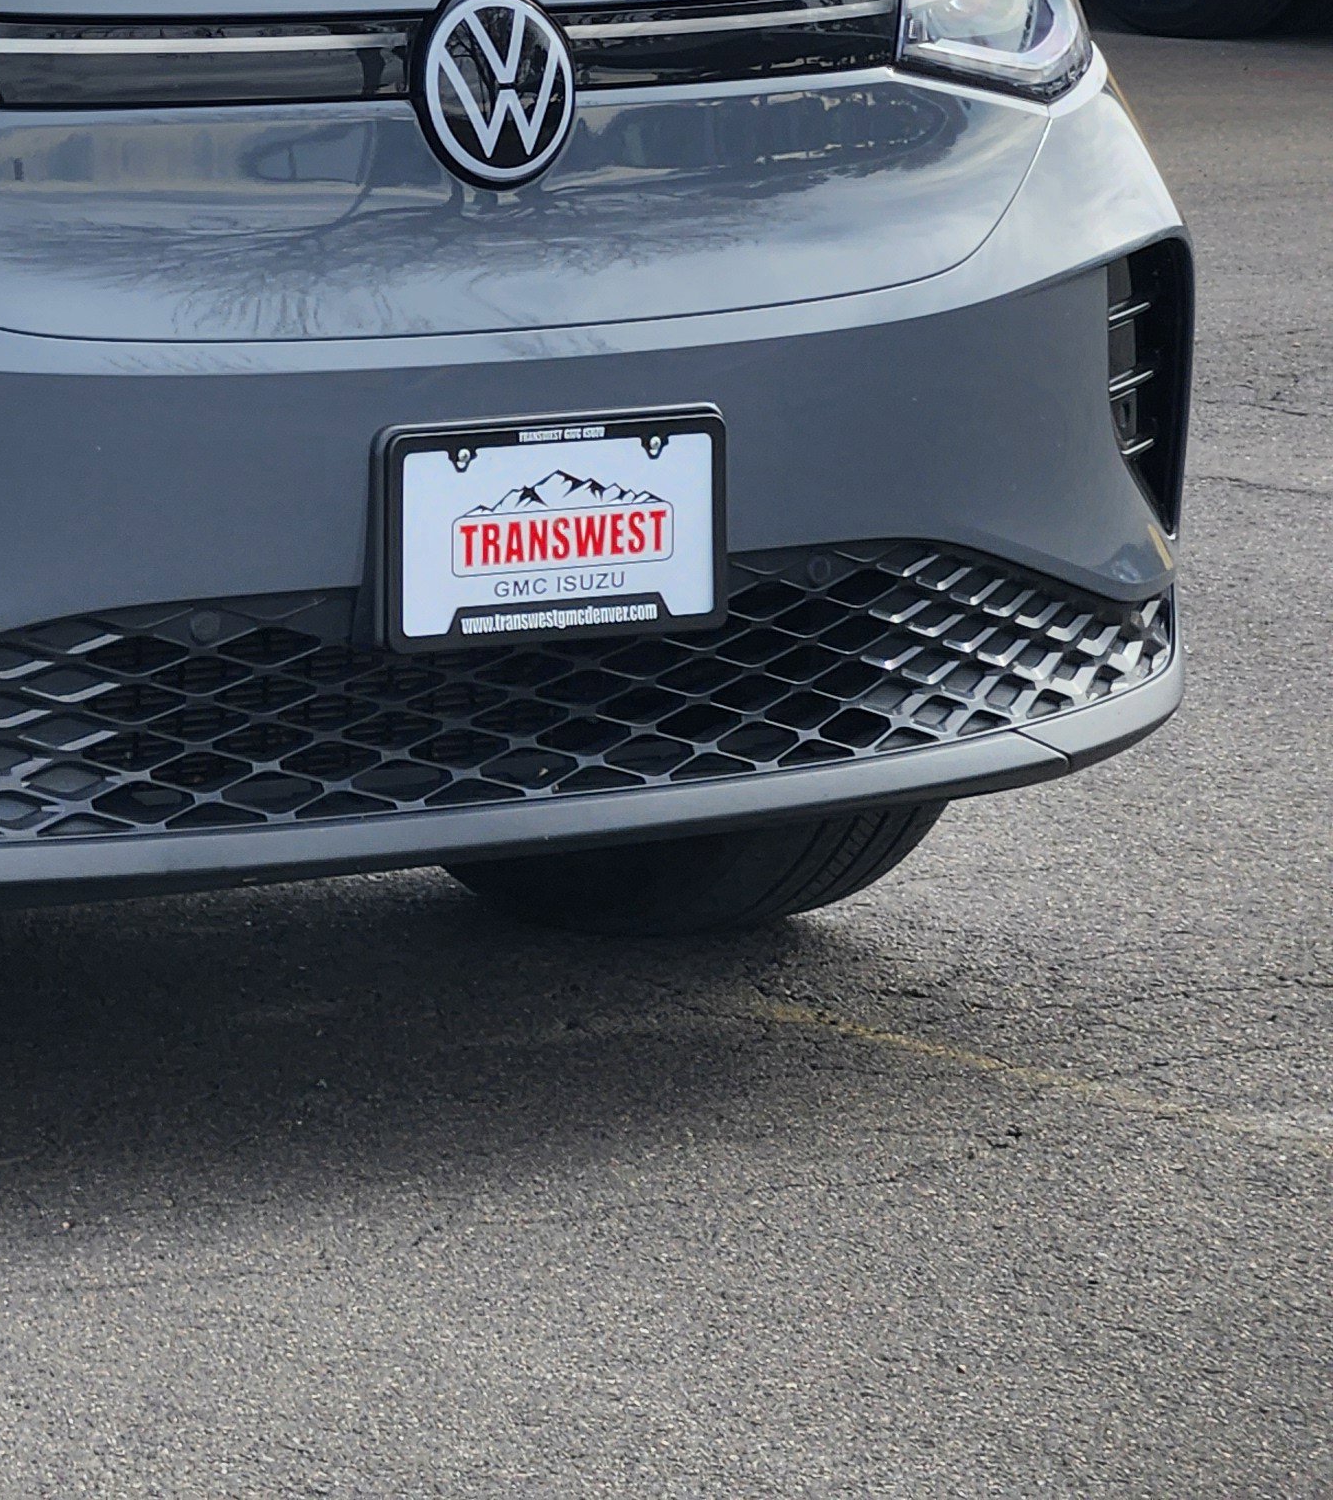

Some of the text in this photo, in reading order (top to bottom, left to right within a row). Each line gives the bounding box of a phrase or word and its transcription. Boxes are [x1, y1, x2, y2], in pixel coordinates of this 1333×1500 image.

[460, 510, 667, 567] TRANSWEST
[494, 571, 625, 597] GMC ISUZU
[460, 602, 658, 635] www.transwestgmcdenver.com
